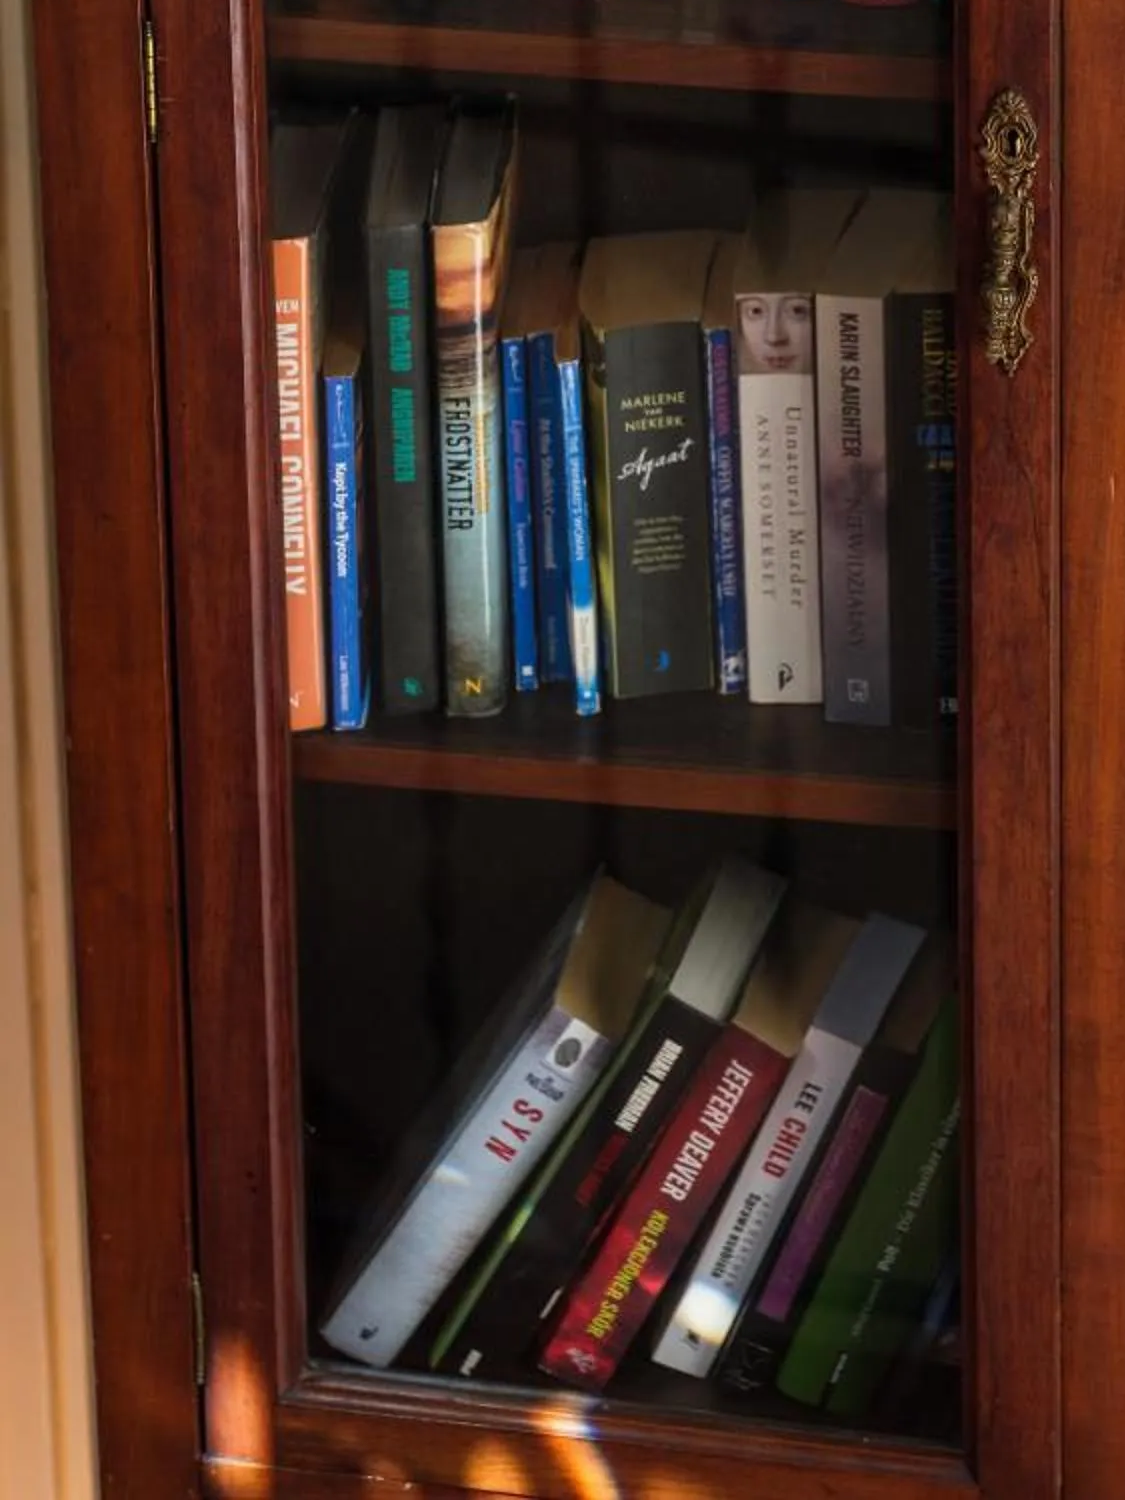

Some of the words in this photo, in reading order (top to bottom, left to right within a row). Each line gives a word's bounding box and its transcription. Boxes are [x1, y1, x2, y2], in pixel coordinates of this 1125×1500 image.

[837, 313, 861, 367] KARIN
[922, 309, 946, 417] BALDACCI
[277, 323, 301, 442] MICHAEL
[619, 391, 686, 411] MARLENE
[839, 368, 863, 459] SLAUGHTER
[624, 415, 685, 433] NIEKERK
[757, 414, 770, 476] ANNE
[335, 462, 350, 491] Kept
[444, 397, 475, 534] FROSTNÄTTER
[617, 438, 695, 491] Agaat
[784, 406, 802, 518] Unnatural
[281, 454, 308, 597] CONNELLY
[335, 494, 350, 508] by
[336, 510, 350, 530] the
[336, 533, 350, 578] Tycoon
[759, 482, 778, 600] SOMERSET
[788, 528, 809, 610] Murder
[484, 1097, 544, 1164] SYN
[698, 1059, 755, 1137] JEFFERY
[793, 1081, 822, 1116] LEE
[659, 1133, 717, 1204] DEAVER
[762, 1116, 808, 1179] CHILD
